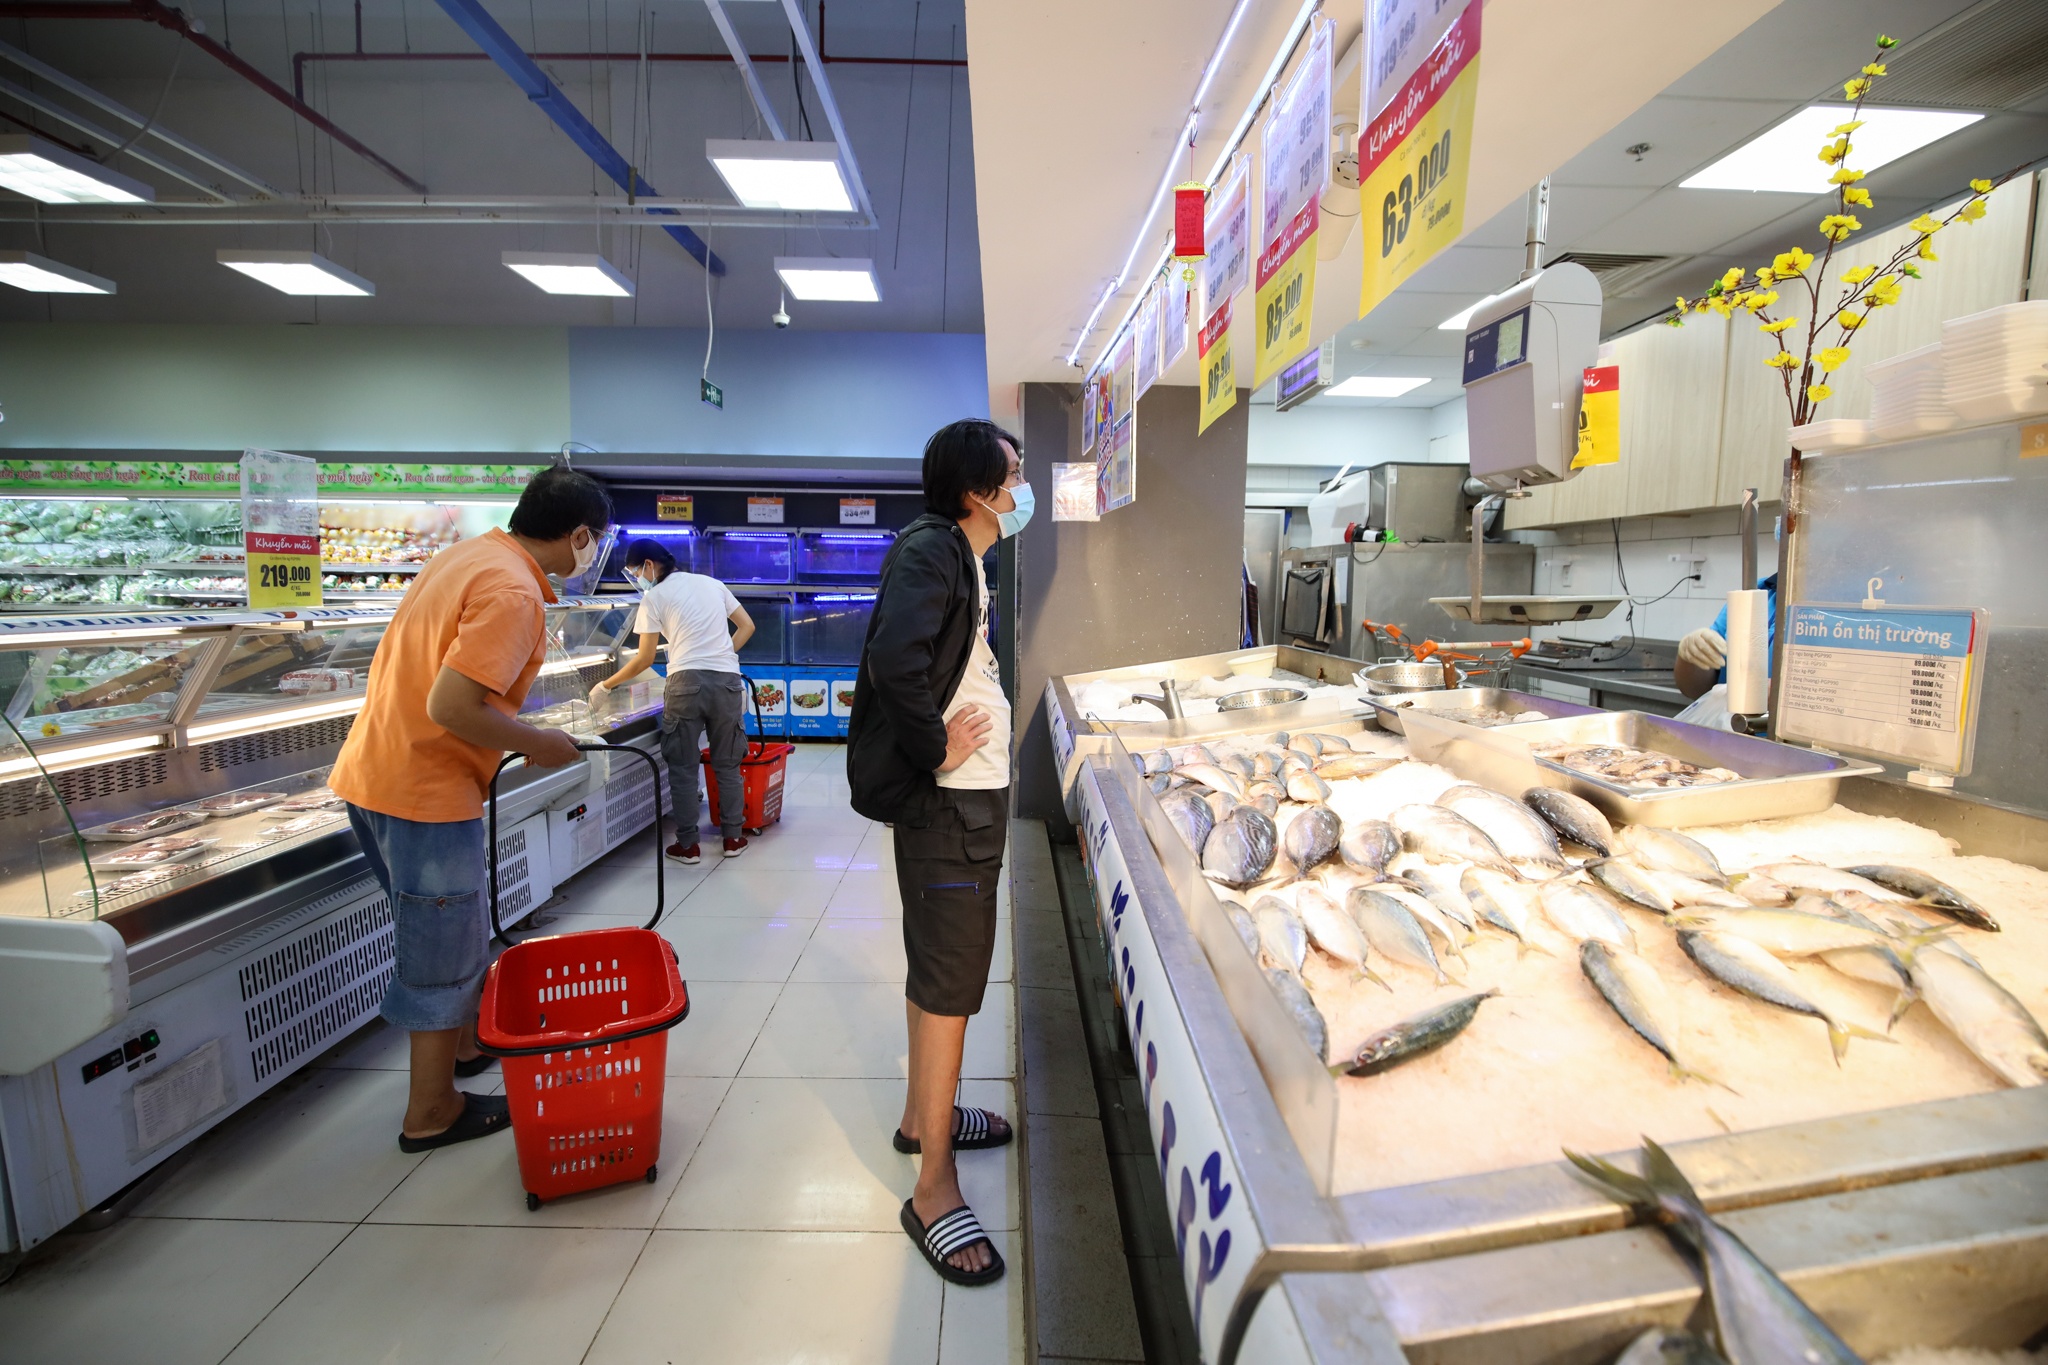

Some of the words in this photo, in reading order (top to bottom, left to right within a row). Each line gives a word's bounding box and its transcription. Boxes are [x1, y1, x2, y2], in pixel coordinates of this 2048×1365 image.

[1369, 78, 1427, 160] Khuyến
[1382, 128, 1451, 259] 63.000
[1262, 229, 1292, 278] Khuyến
[1293, 210, 1313, 243] mãi
[1266, 272, 1303, 350] 85.000
[255, 537, 292, 551] Khuyến
[294, 540, 312, 549] mãi
[260, 564, 311, 587] 219.000
[1795, 621, 1828, 637] Bình
[1833, 620, 1853, 639] ổn
[1858, 624, 1880, 644] thị
[1885, 626, 1952, 649] trường
